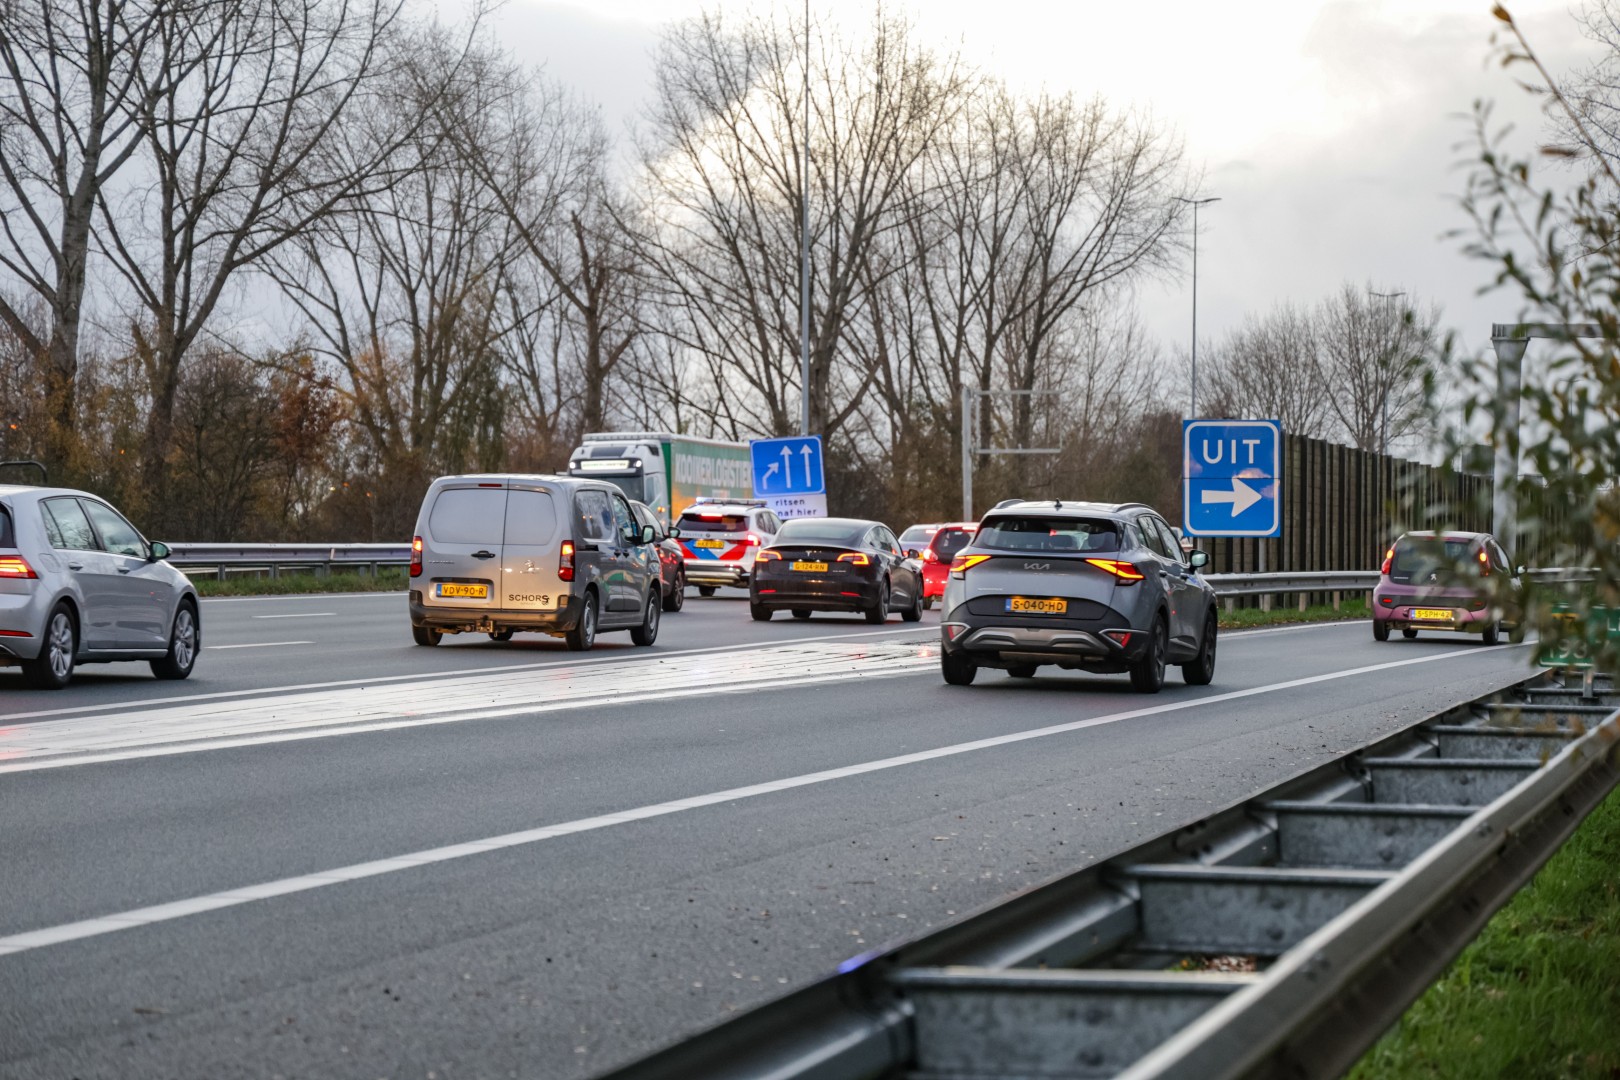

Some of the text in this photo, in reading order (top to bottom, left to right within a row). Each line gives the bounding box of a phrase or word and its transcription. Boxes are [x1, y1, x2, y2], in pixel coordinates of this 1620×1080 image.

[1203, 439, 1260, 464] UIT
[775, 499, 805, 507] ritsen
[777, 508, 818, 517] naf hier
[443, 586, 484, 596] VDV-90-R
[1013, 600, 1064, 611] S-040-HD
